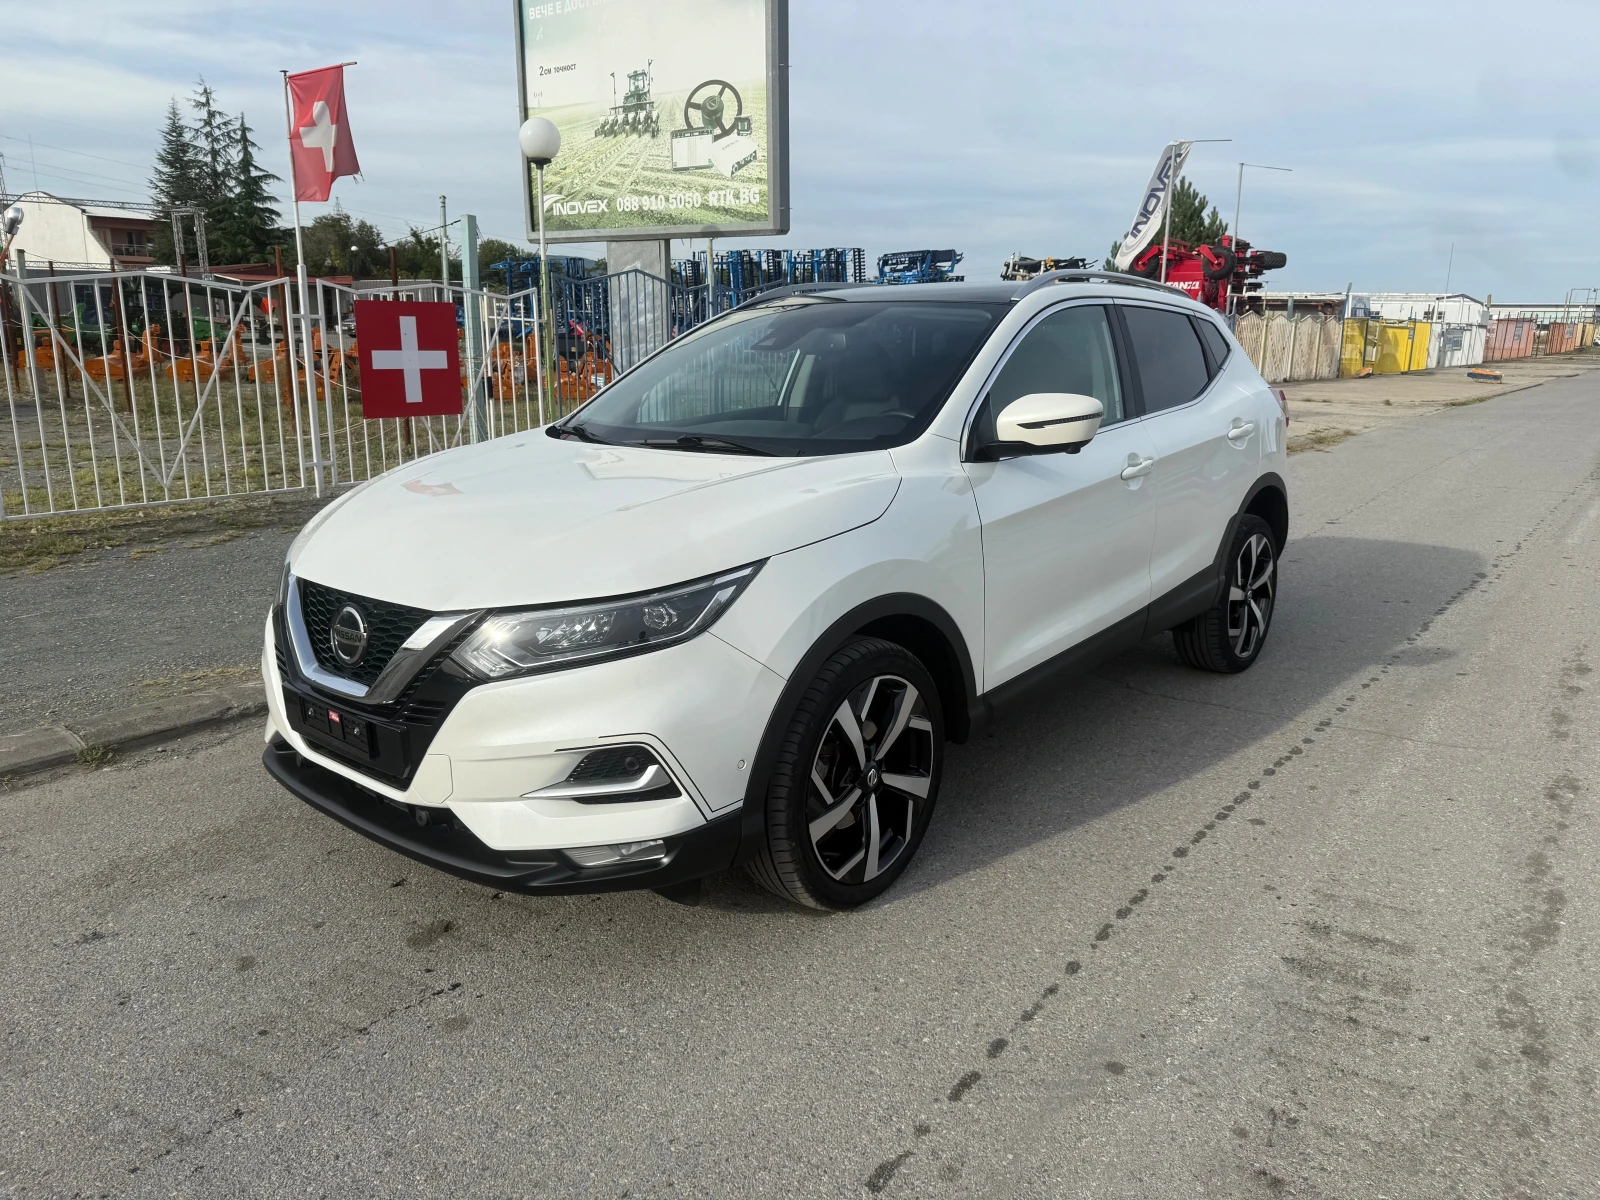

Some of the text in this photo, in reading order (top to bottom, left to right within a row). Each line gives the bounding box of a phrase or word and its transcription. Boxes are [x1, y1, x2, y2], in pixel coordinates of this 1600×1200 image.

[528, 2, 554, 20] ВЕЧЕ
[539, 65, 552, 76] 2см
[553, 199, 608, 216] INOVEX
[616, 186, 760, 212] 088 910 5050 RTK.BG
[336, 629, 362, 644] NISSAN
